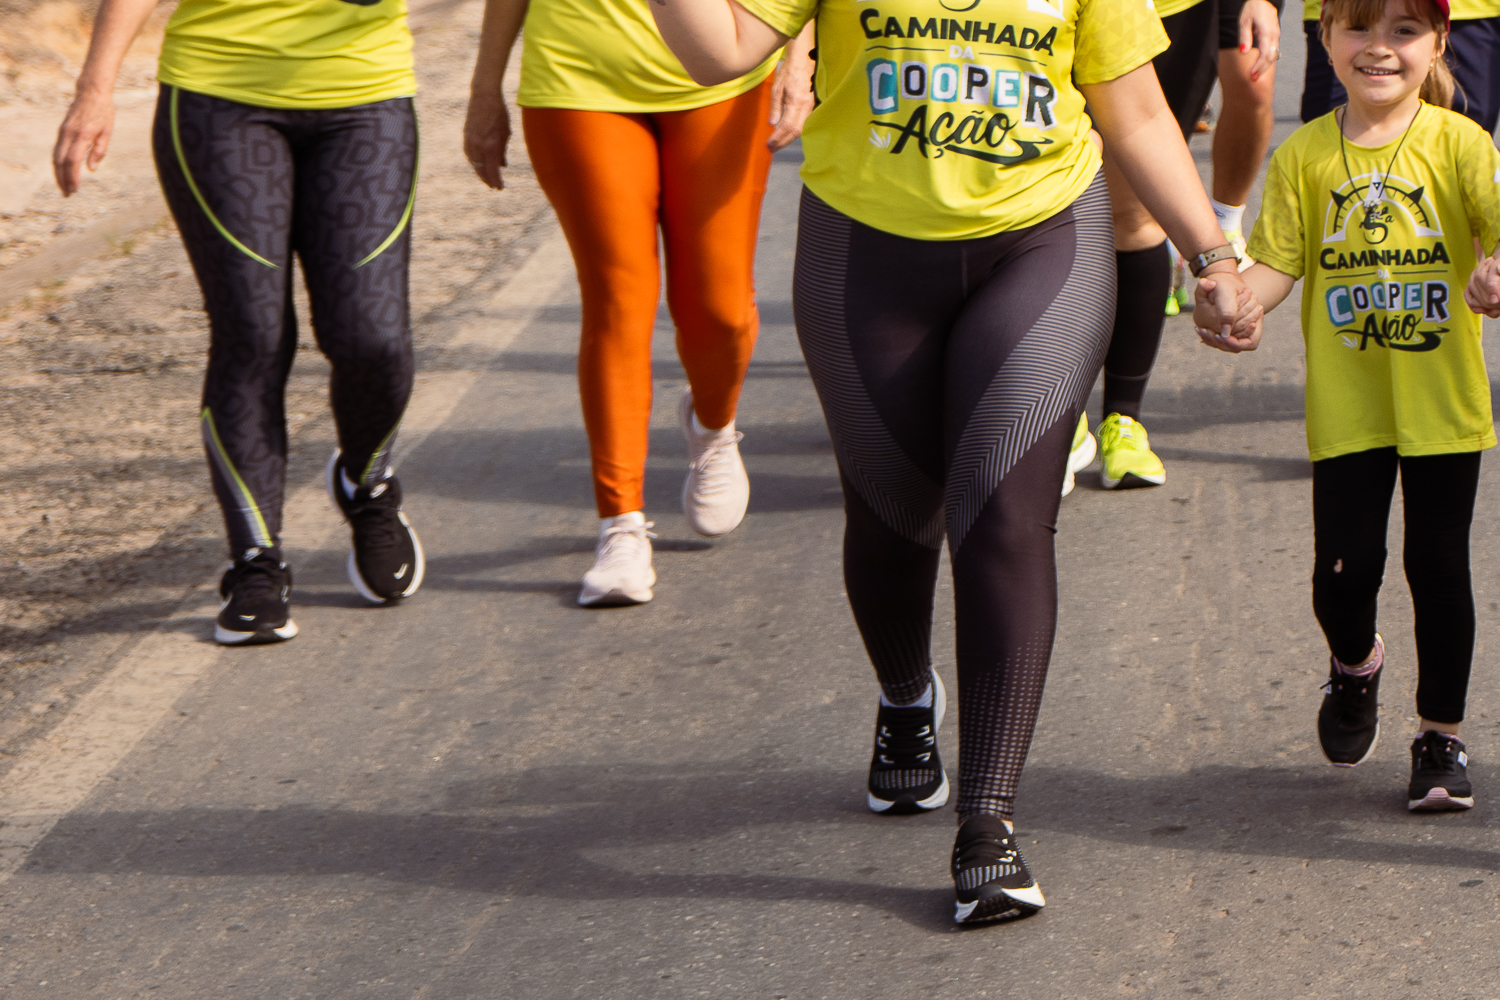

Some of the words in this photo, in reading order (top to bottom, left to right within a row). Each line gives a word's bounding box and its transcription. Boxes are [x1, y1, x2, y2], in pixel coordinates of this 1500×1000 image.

[860, 8, 1058, 56] CAMINHADA
[949, 45, 975, 60] DA
[868, 60, 1057, 129] COOPER
[870, 105, 1019, 159] Ação
[1320, 242, 1451, 270] CAMINHADA
[1377, 268, 1391, 279] DA
[1327, 282, 1449, 325] COOPER
